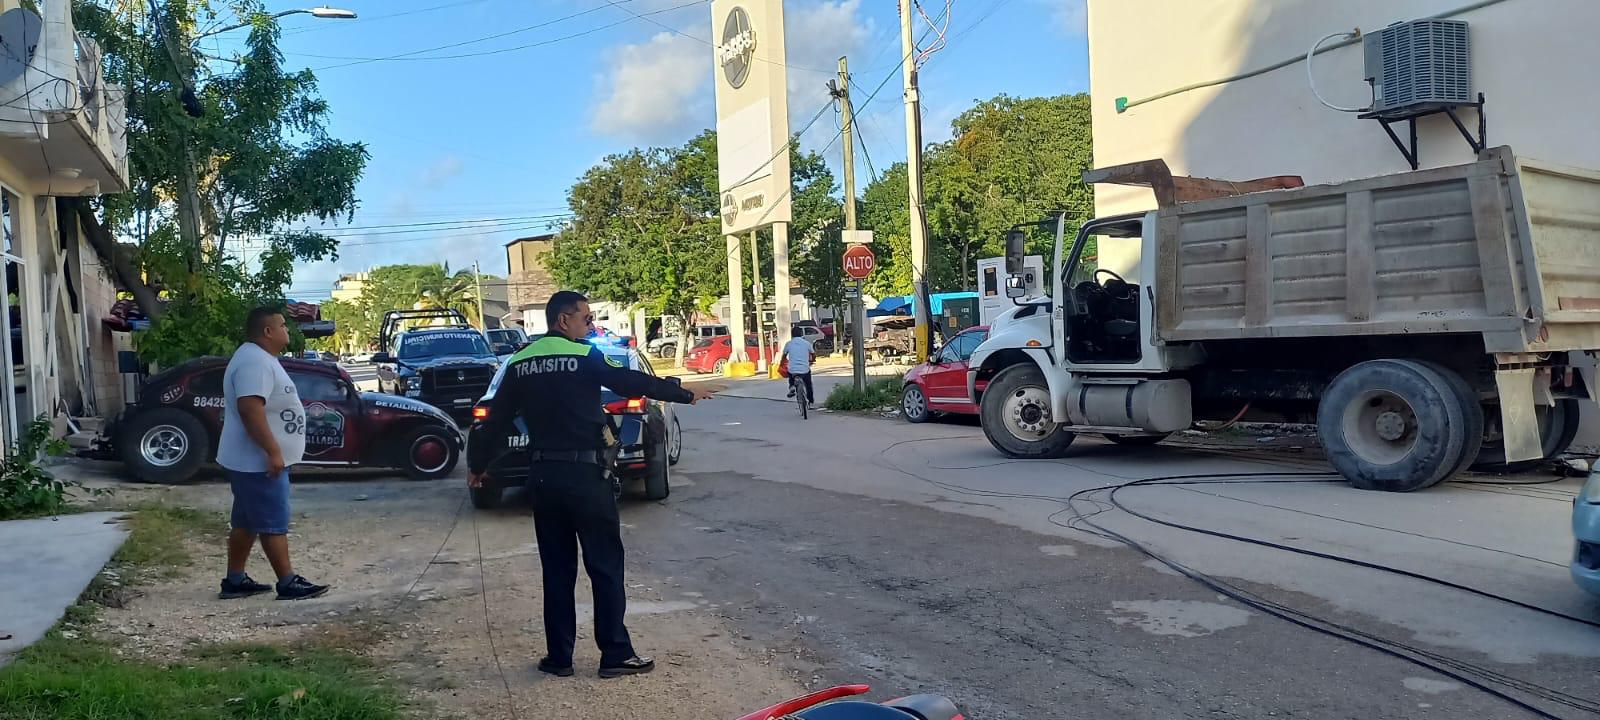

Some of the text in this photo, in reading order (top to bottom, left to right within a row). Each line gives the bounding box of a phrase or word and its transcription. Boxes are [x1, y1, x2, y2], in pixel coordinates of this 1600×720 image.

[846, 256, 873, 270] ALTO
[515, 357, 578, 378] TRÁNSITO
[375, 400, 424, 413] DETAILING
